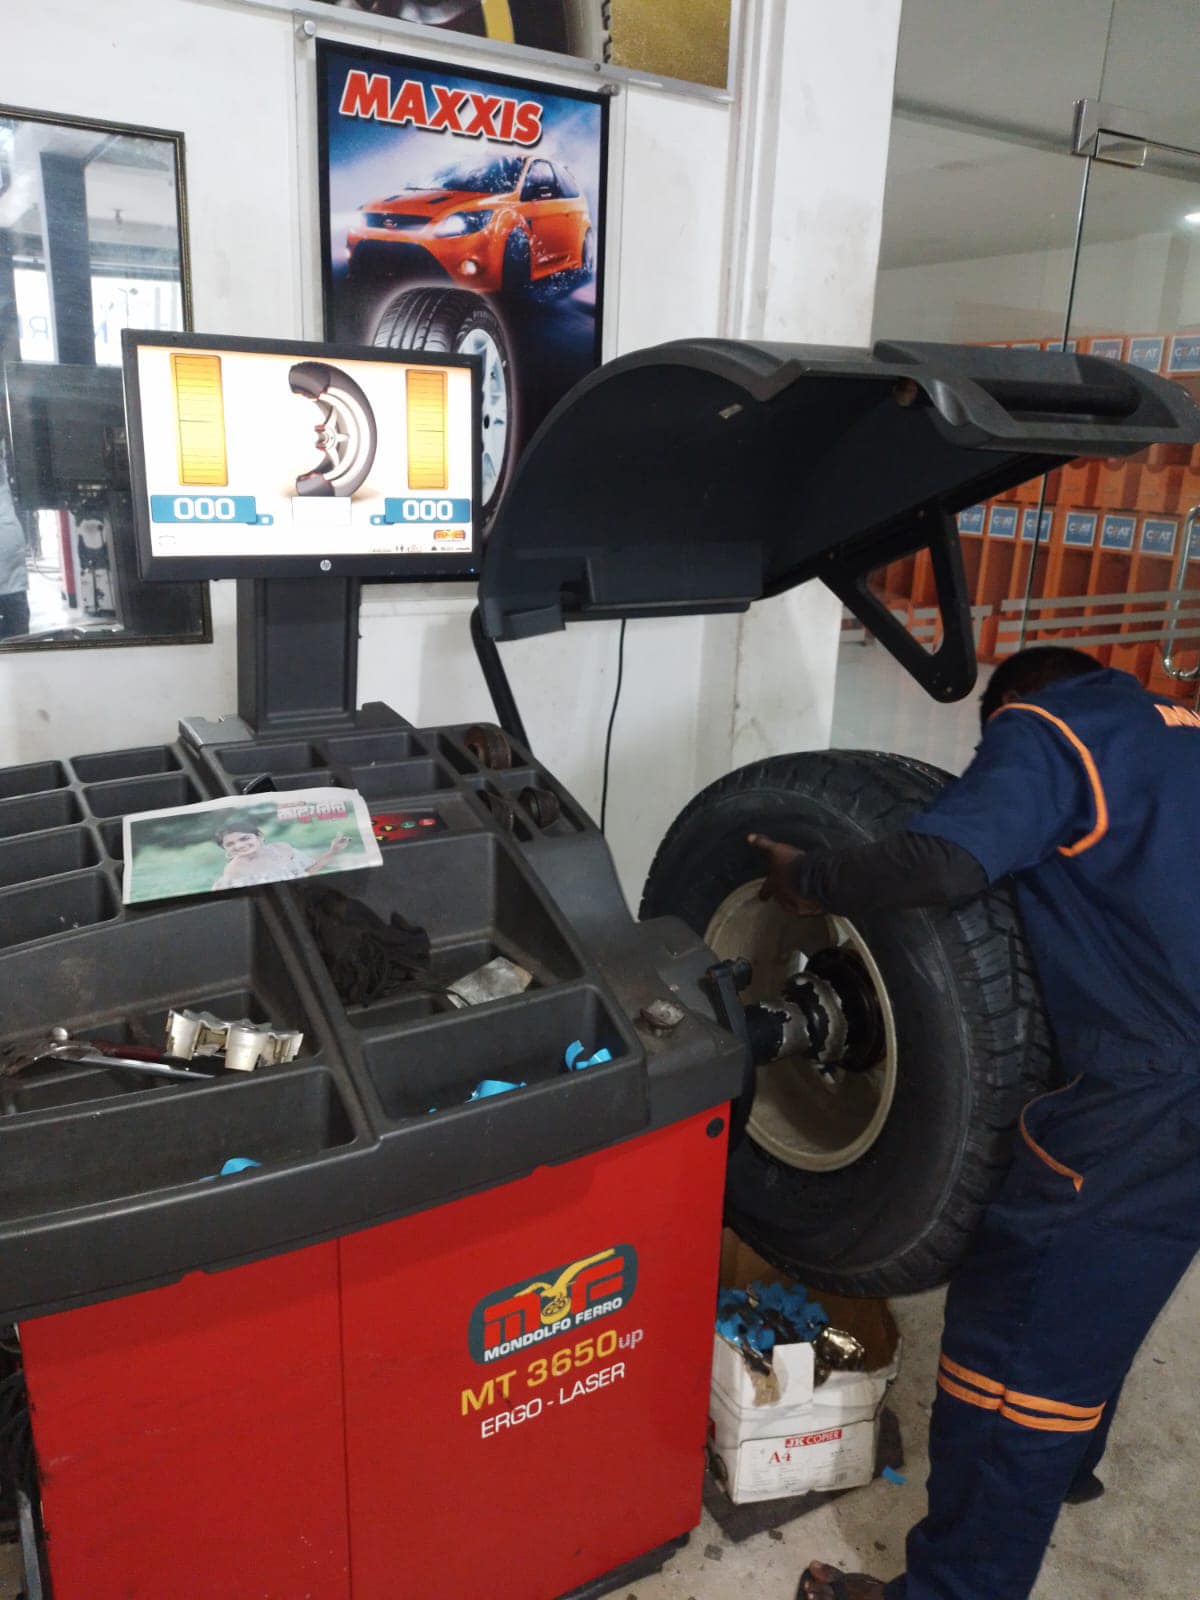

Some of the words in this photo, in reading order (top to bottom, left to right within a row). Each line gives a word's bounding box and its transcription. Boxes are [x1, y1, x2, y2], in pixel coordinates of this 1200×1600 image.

[339, 69, 543, 146] MAXXIS
[173, 497, 236, 521] 000
[401, 500, 454, 521] 000
[484, 1318, 571, 1362] MONDOLFO
[575, 1297, 623, 1325] FERRO
[461, 1369, 517, 1416] MT
[481, 1398, 543, 1439] ERGO
[558, 1362, 625, 1405] LASER
